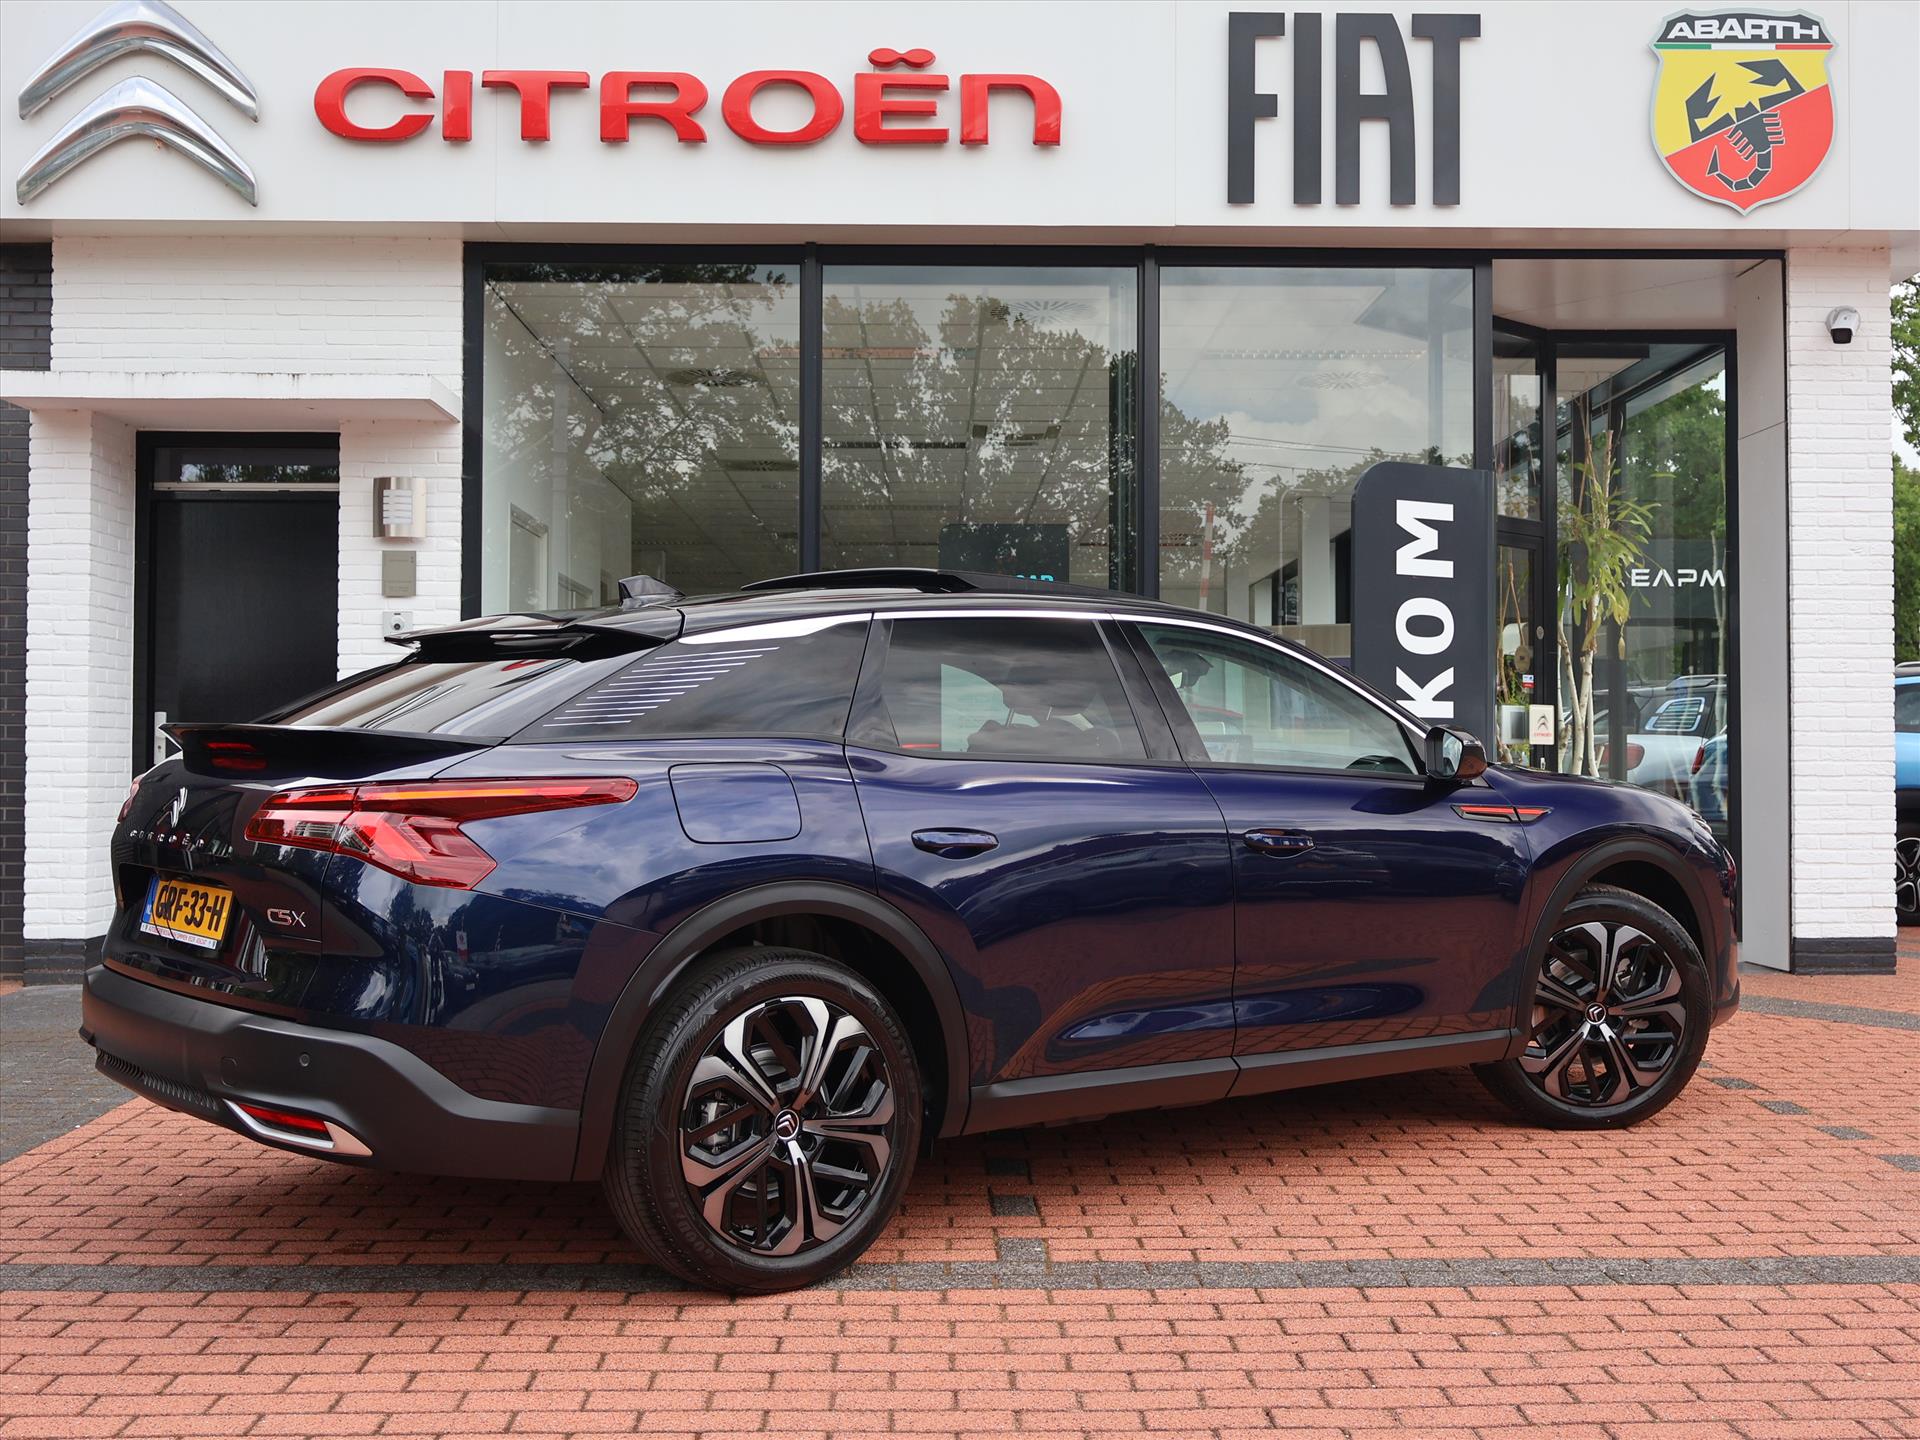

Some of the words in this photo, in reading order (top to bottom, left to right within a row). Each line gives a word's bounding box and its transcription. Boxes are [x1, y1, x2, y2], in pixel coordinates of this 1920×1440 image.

[1666, 18, 1820, 40] ABARTH
[314, 48, 1062, 146] CITROËN
[1228, 12, 1481, 206] FIAT
[156, 884, 226, 932] GRF-33-H
